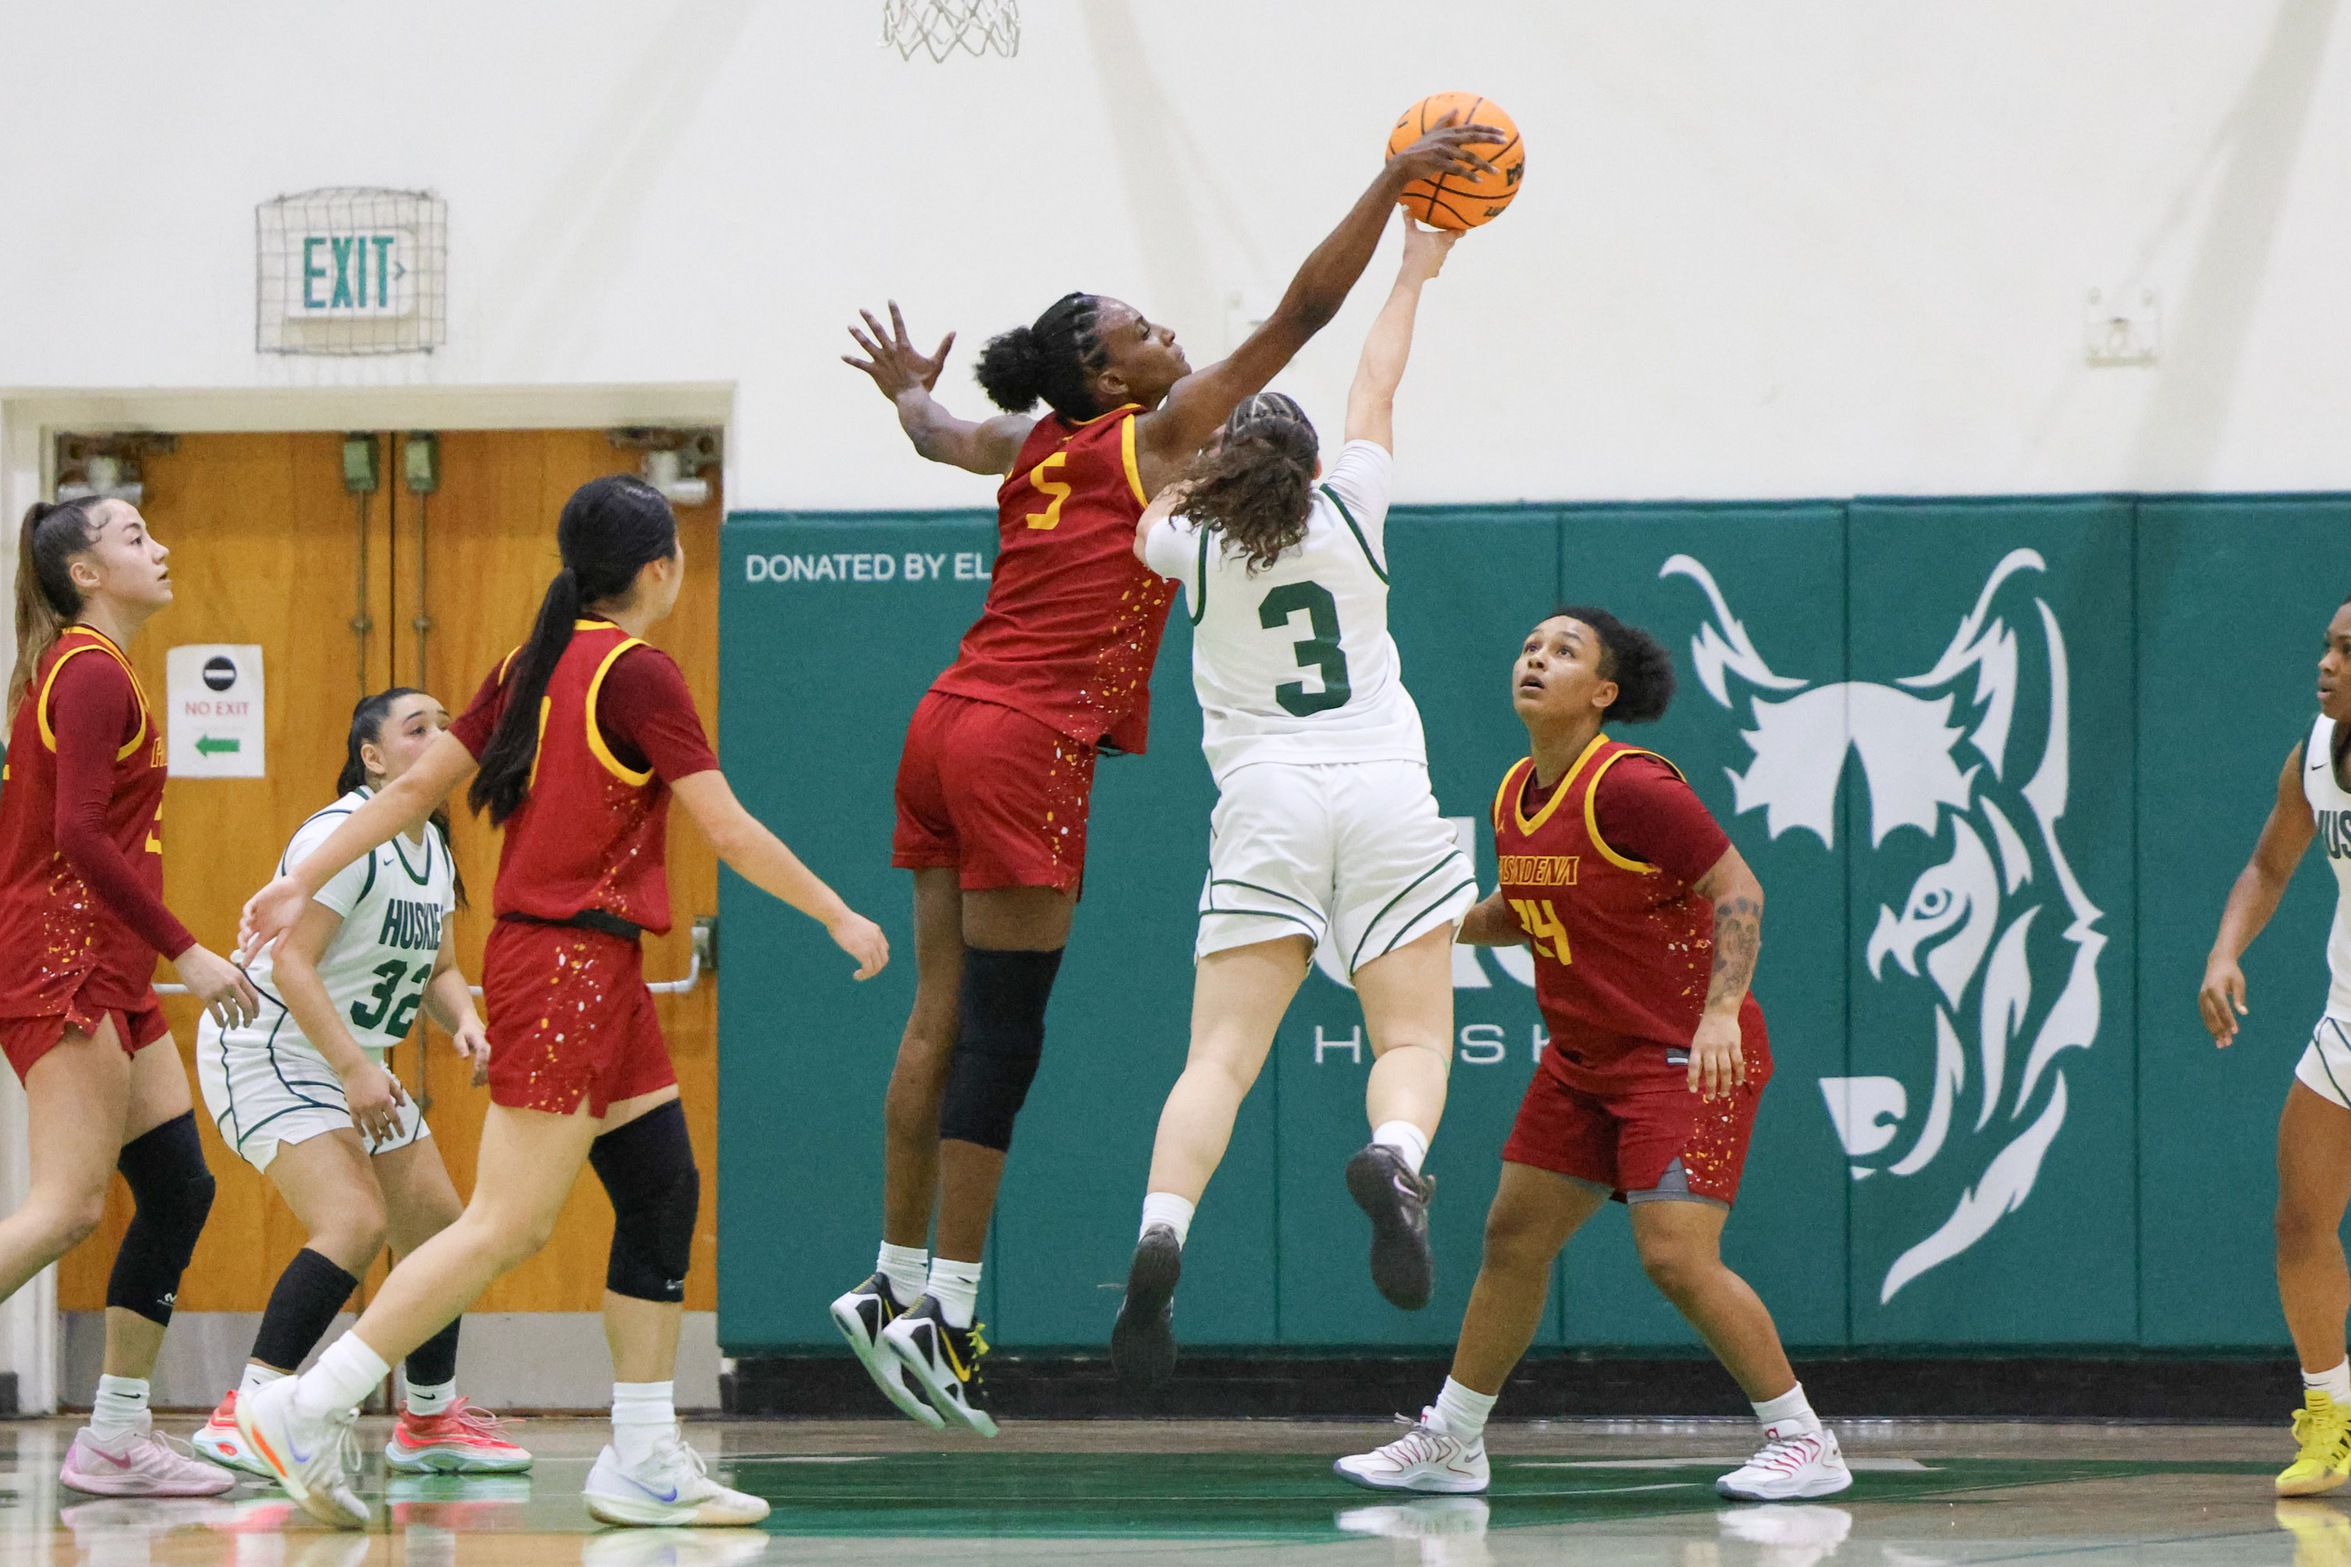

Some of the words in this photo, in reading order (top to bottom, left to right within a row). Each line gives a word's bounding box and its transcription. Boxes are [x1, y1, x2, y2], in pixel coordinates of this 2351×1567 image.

[303, 236, 394, 308] EXIT
[1026, 452, 1071, 530] 5
[746, 554, 896, 582] DONATED
[904, 553, 946, 581] BY
[1258, 580, 1351, 717] 3
[185, 702, 211, 716] NO
[215, 702, 250, 716] EXIT
[1498, 855, 1580, 886] SADENA
[378, 898, 444, 950] HUSKIE
[350, 959, 432, 1038] 32
